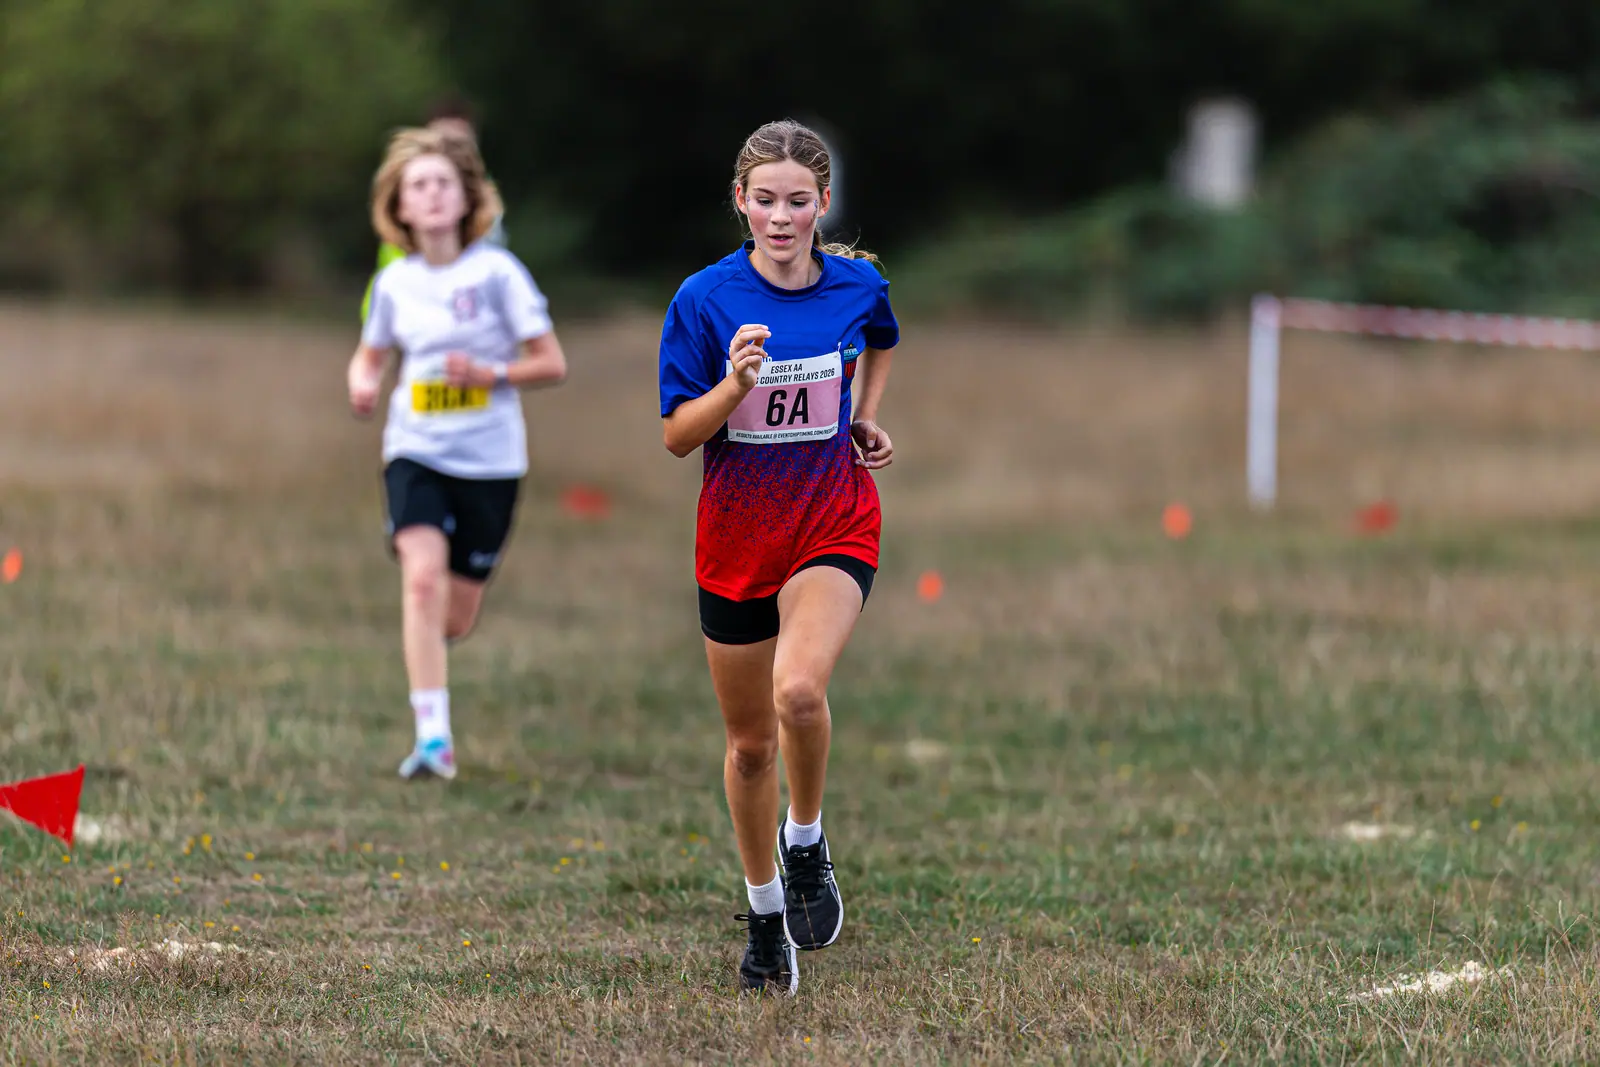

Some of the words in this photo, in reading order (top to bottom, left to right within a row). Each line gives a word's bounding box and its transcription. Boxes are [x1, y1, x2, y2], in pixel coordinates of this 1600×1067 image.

[760, 374, 792, 385] COUNTRY
[793, 371, 819, 382] RELAYS
[820, 368, 835, 379] 2026
[771, 364, 792, 374] ESSEX
[793, 364, 803, 372] AA
[765, 387, 809, 427] 6A
